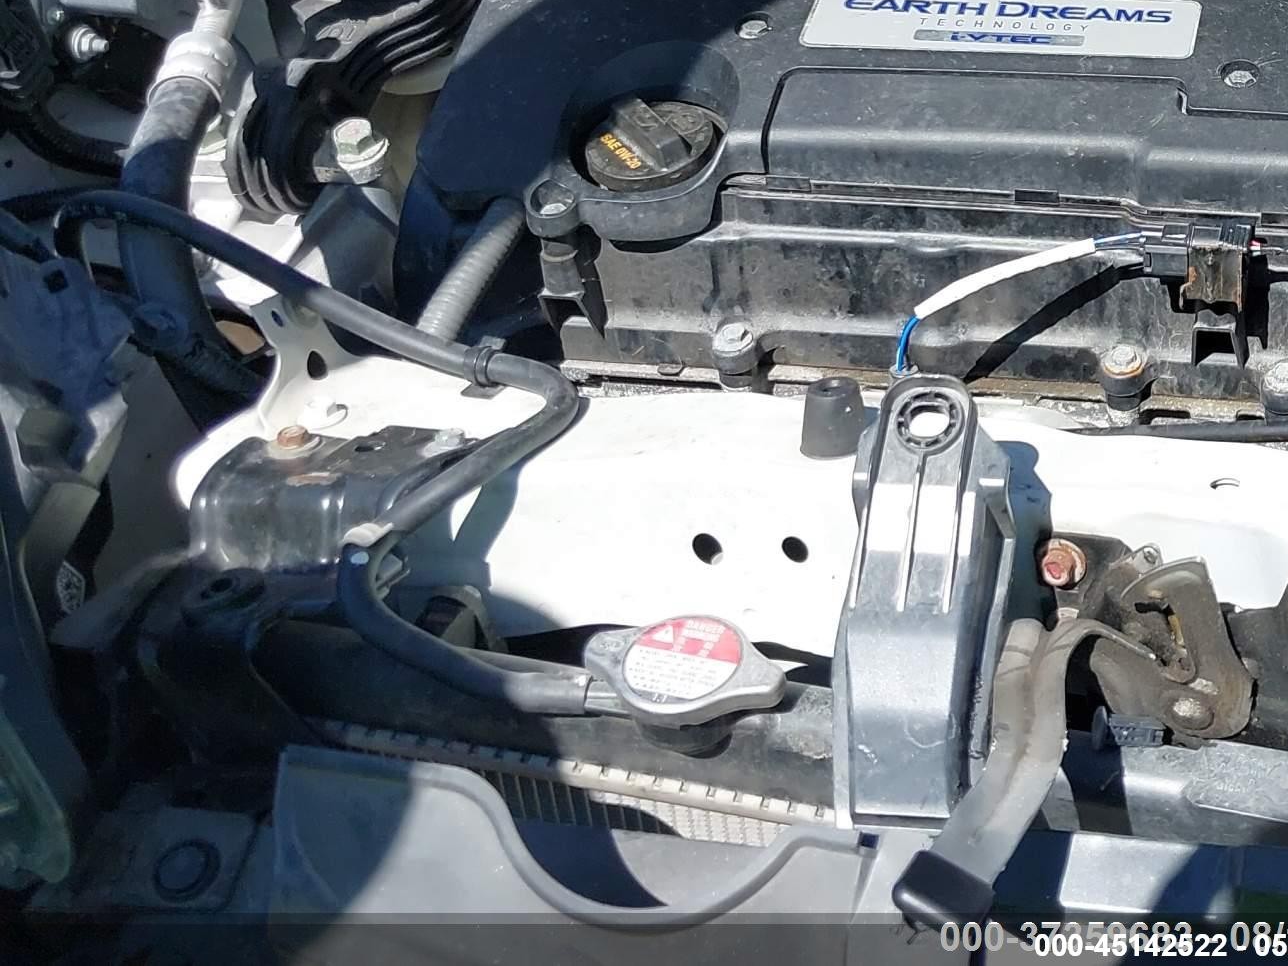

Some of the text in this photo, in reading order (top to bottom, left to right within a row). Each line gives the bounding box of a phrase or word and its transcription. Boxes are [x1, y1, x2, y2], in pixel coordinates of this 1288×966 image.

[995, 0, 1173, 24] DREAMS
[919, 17, 1091, 32] TECHNOLOGY
[950, 31, 1052, 45] i-VTEC
[600, 133, 622, 151] SAE
